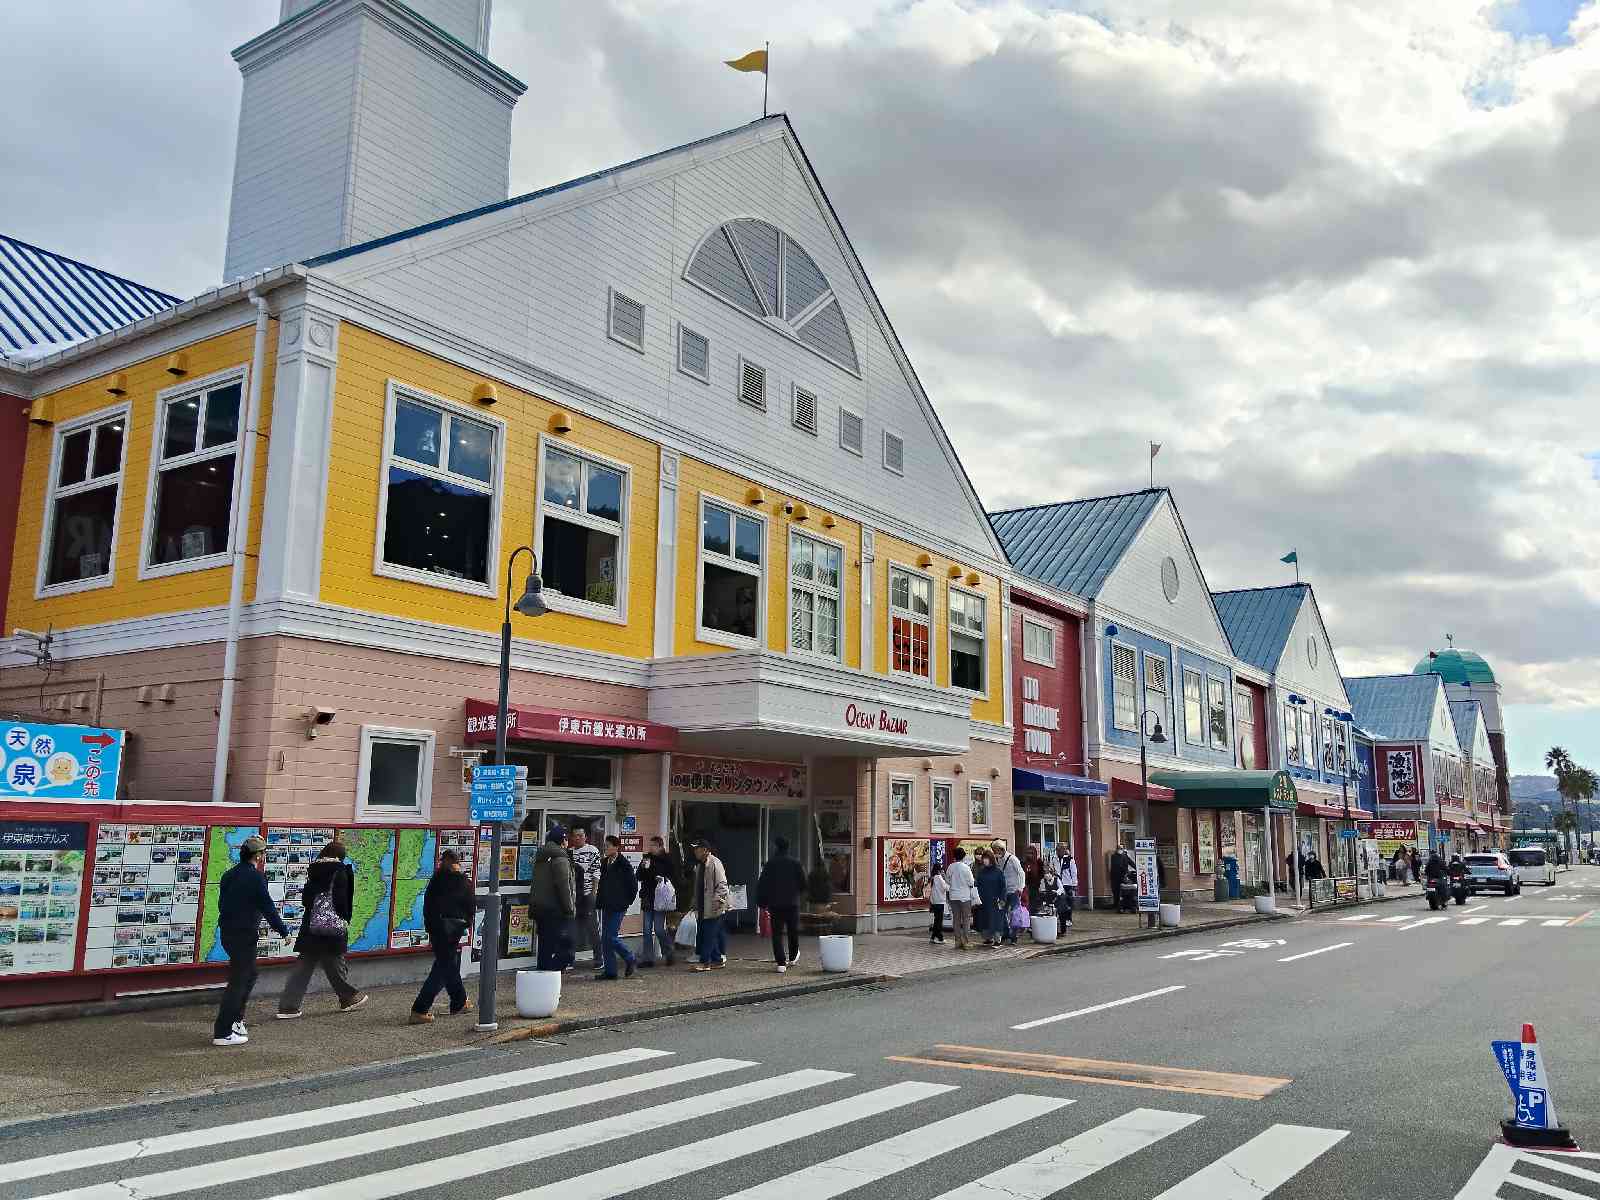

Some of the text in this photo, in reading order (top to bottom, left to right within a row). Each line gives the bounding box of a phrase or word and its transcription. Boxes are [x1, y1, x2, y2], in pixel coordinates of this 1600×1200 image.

[467, 712, 517, 732] 観光案所
[559, 717, 647, 741] 伊東市観光案内所
[846, 704, 908, 735] OCEAN BAZAAR
[1529, 1092, 1543, 1108] P
